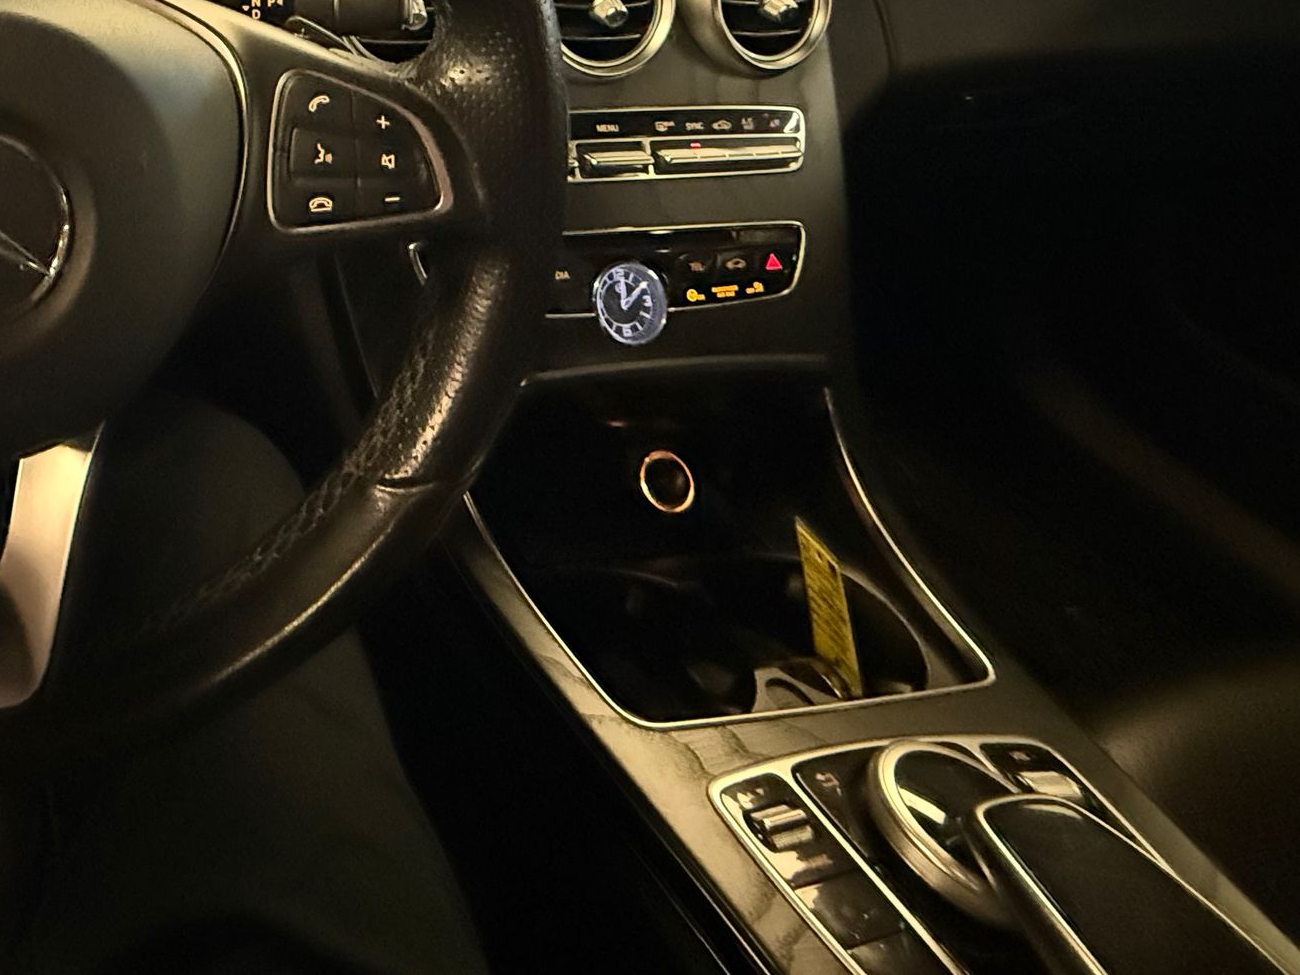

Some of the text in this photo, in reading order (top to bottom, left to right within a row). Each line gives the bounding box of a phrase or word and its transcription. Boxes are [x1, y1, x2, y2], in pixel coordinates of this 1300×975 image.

[251, 9, 261, 20] D
[596, 124, 620, 133] MENU
[555, 270, 571, 280] DIA
[642, 295, 654, 307] 3
[622, 326, 633, 338] 6
